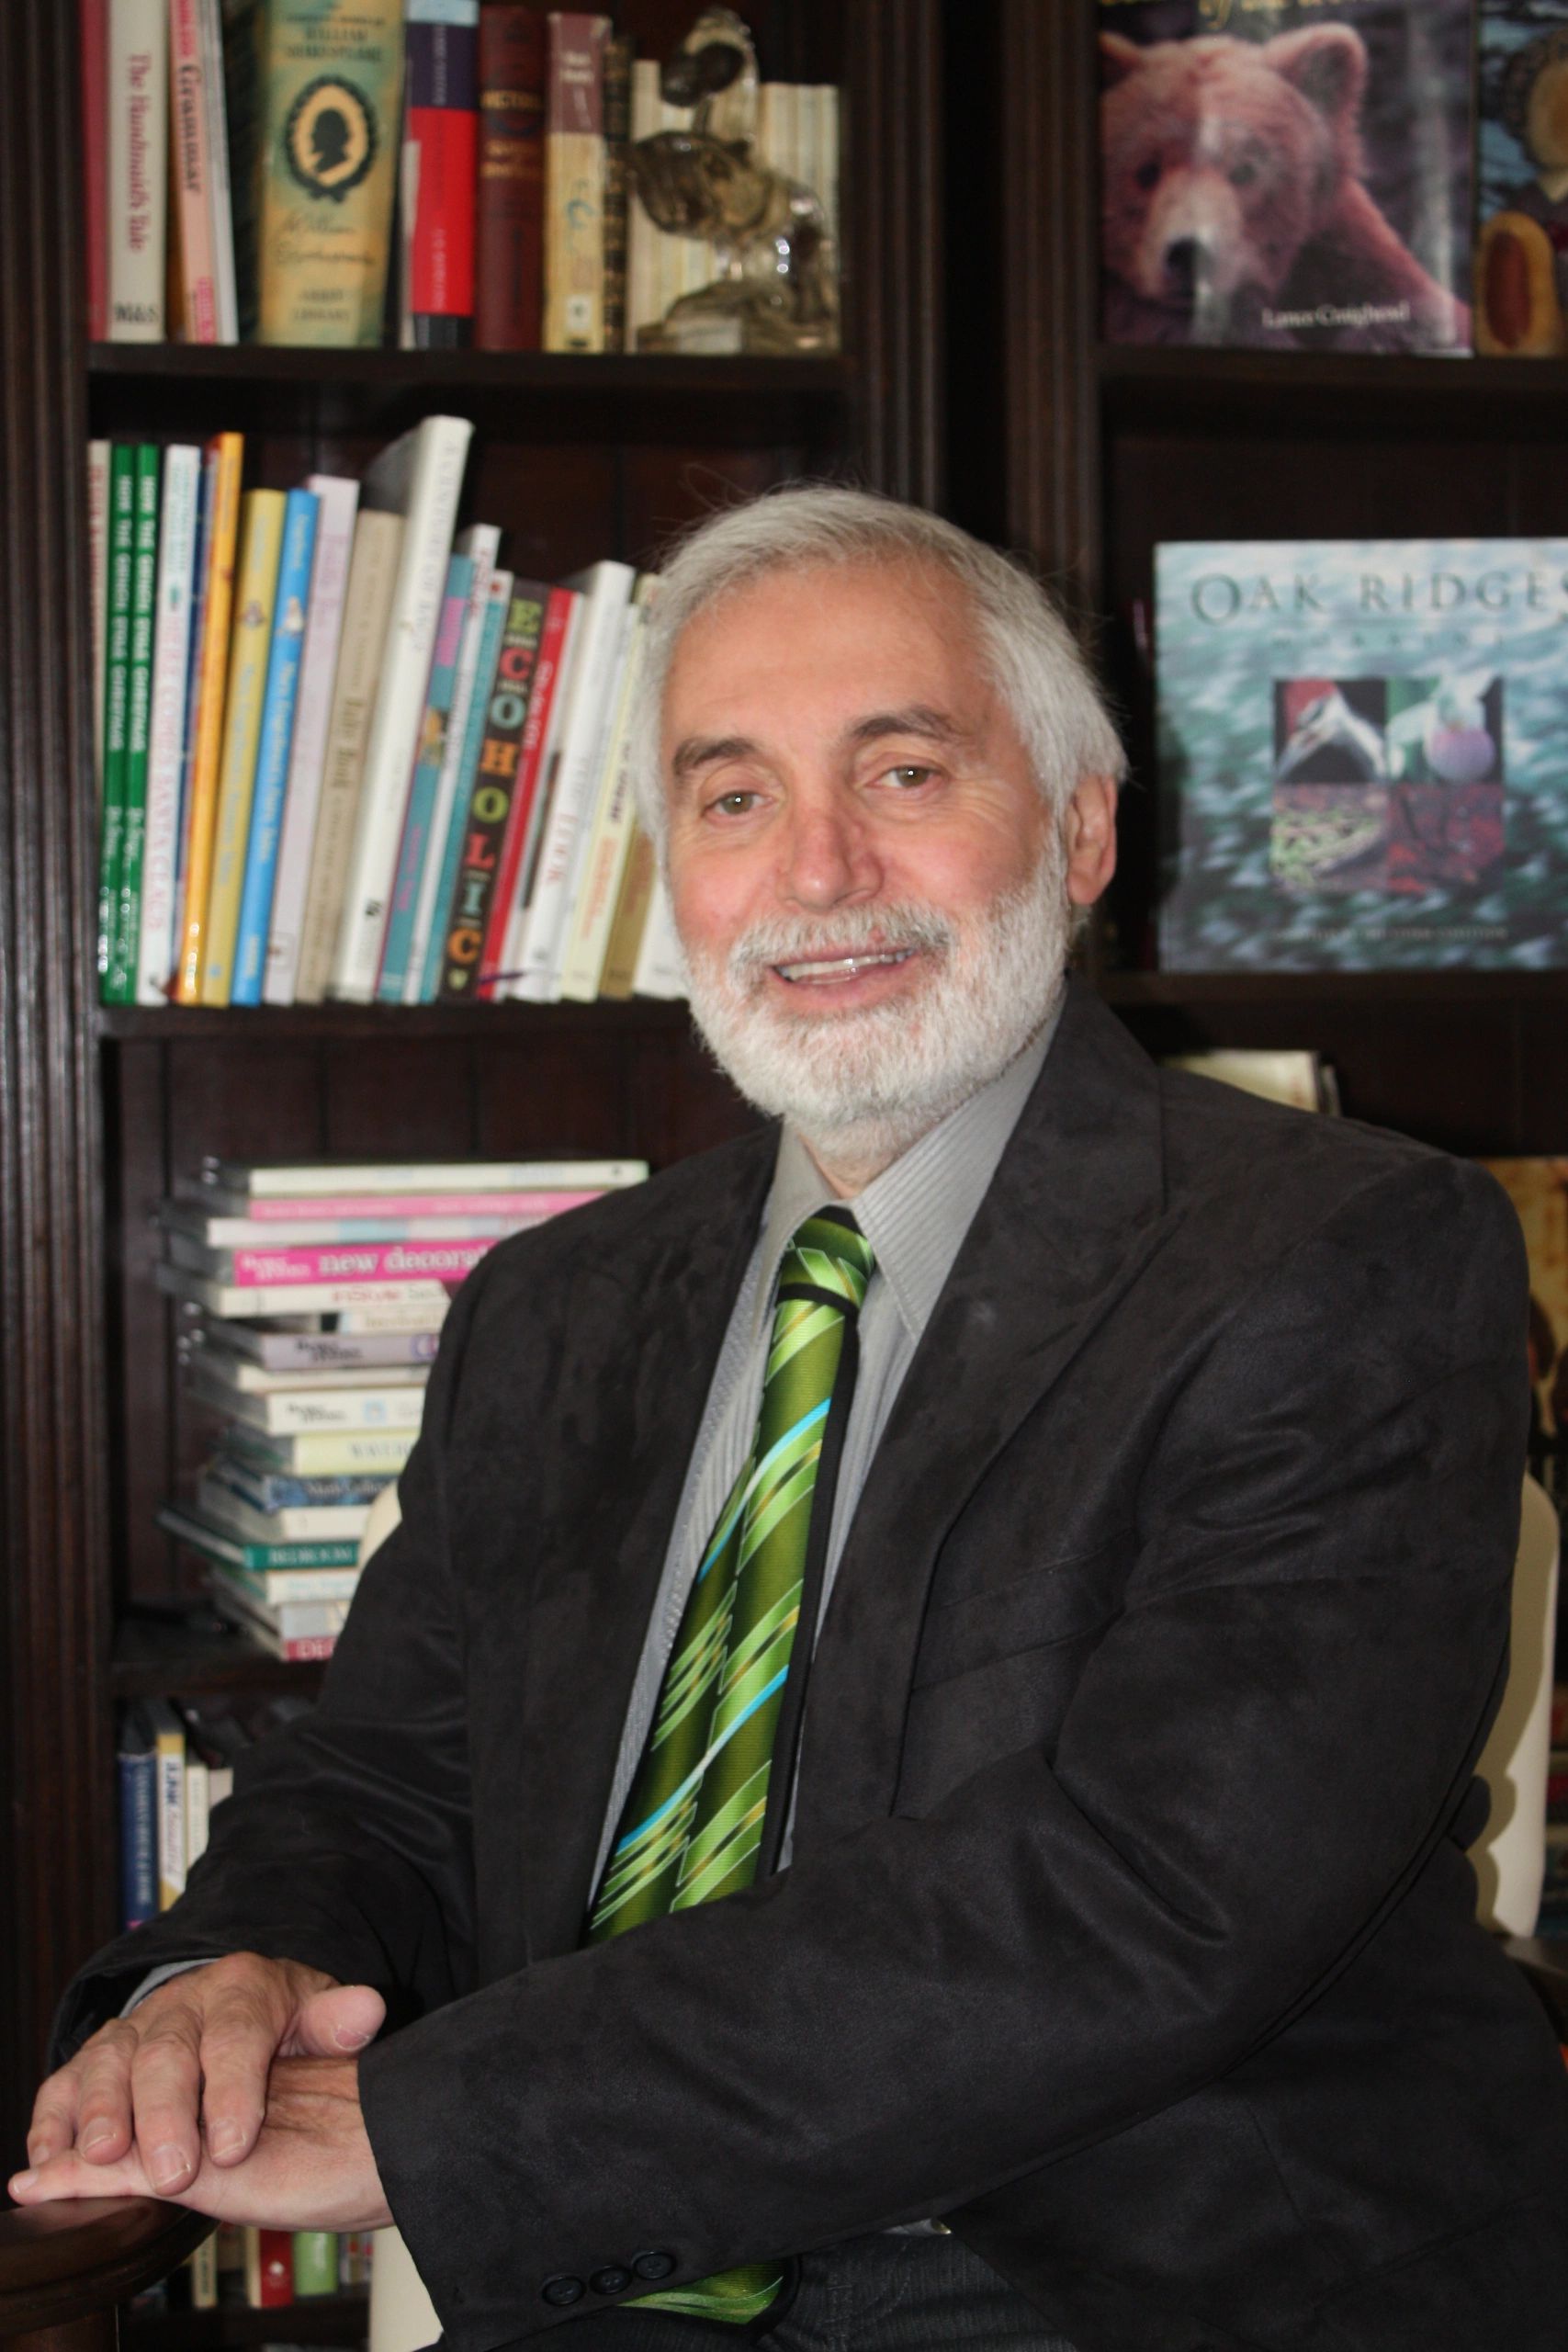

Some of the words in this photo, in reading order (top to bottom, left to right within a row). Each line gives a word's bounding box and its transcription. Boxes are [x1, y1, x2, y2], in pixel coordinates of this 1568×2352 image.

[128, 53, 151, 89] The
[178, 64, 202, 194] Grammar
[127, 213, 151, 253] Tale
[1190, 573, 1326, 625] OAK
[151, 774, 174, 850] SANTA
[446, 597, 544, 965] ECOHOLIC
[146, 855, 169, 931] CLAUS
[318, 1250, 378, 1274] new
